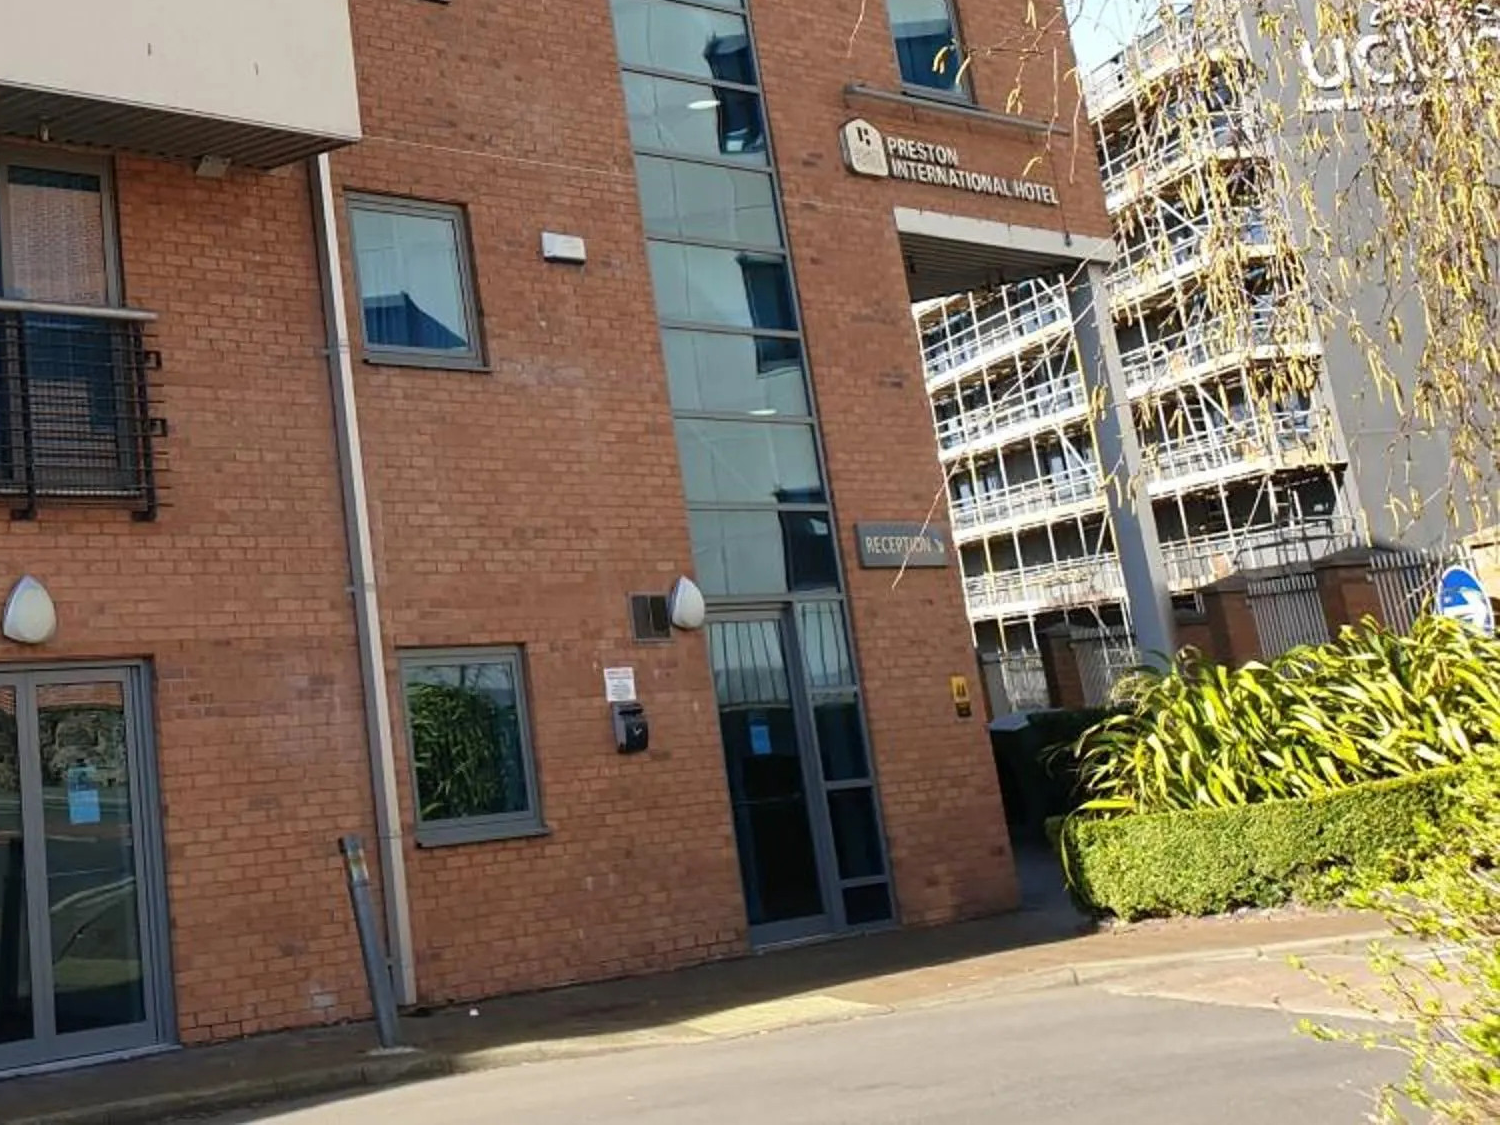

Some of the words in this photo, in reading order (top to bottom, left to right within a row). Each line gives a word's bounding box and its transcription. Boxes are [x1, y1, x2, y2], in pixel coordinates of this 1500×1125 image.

[886, 136, 959, 166] PRESTON
[890, 159, 1014, 197] INTERNATIONAL
[1014, 178, 1060, 205] HOTEL
[865, 535, 932, 554] RECEPTION
